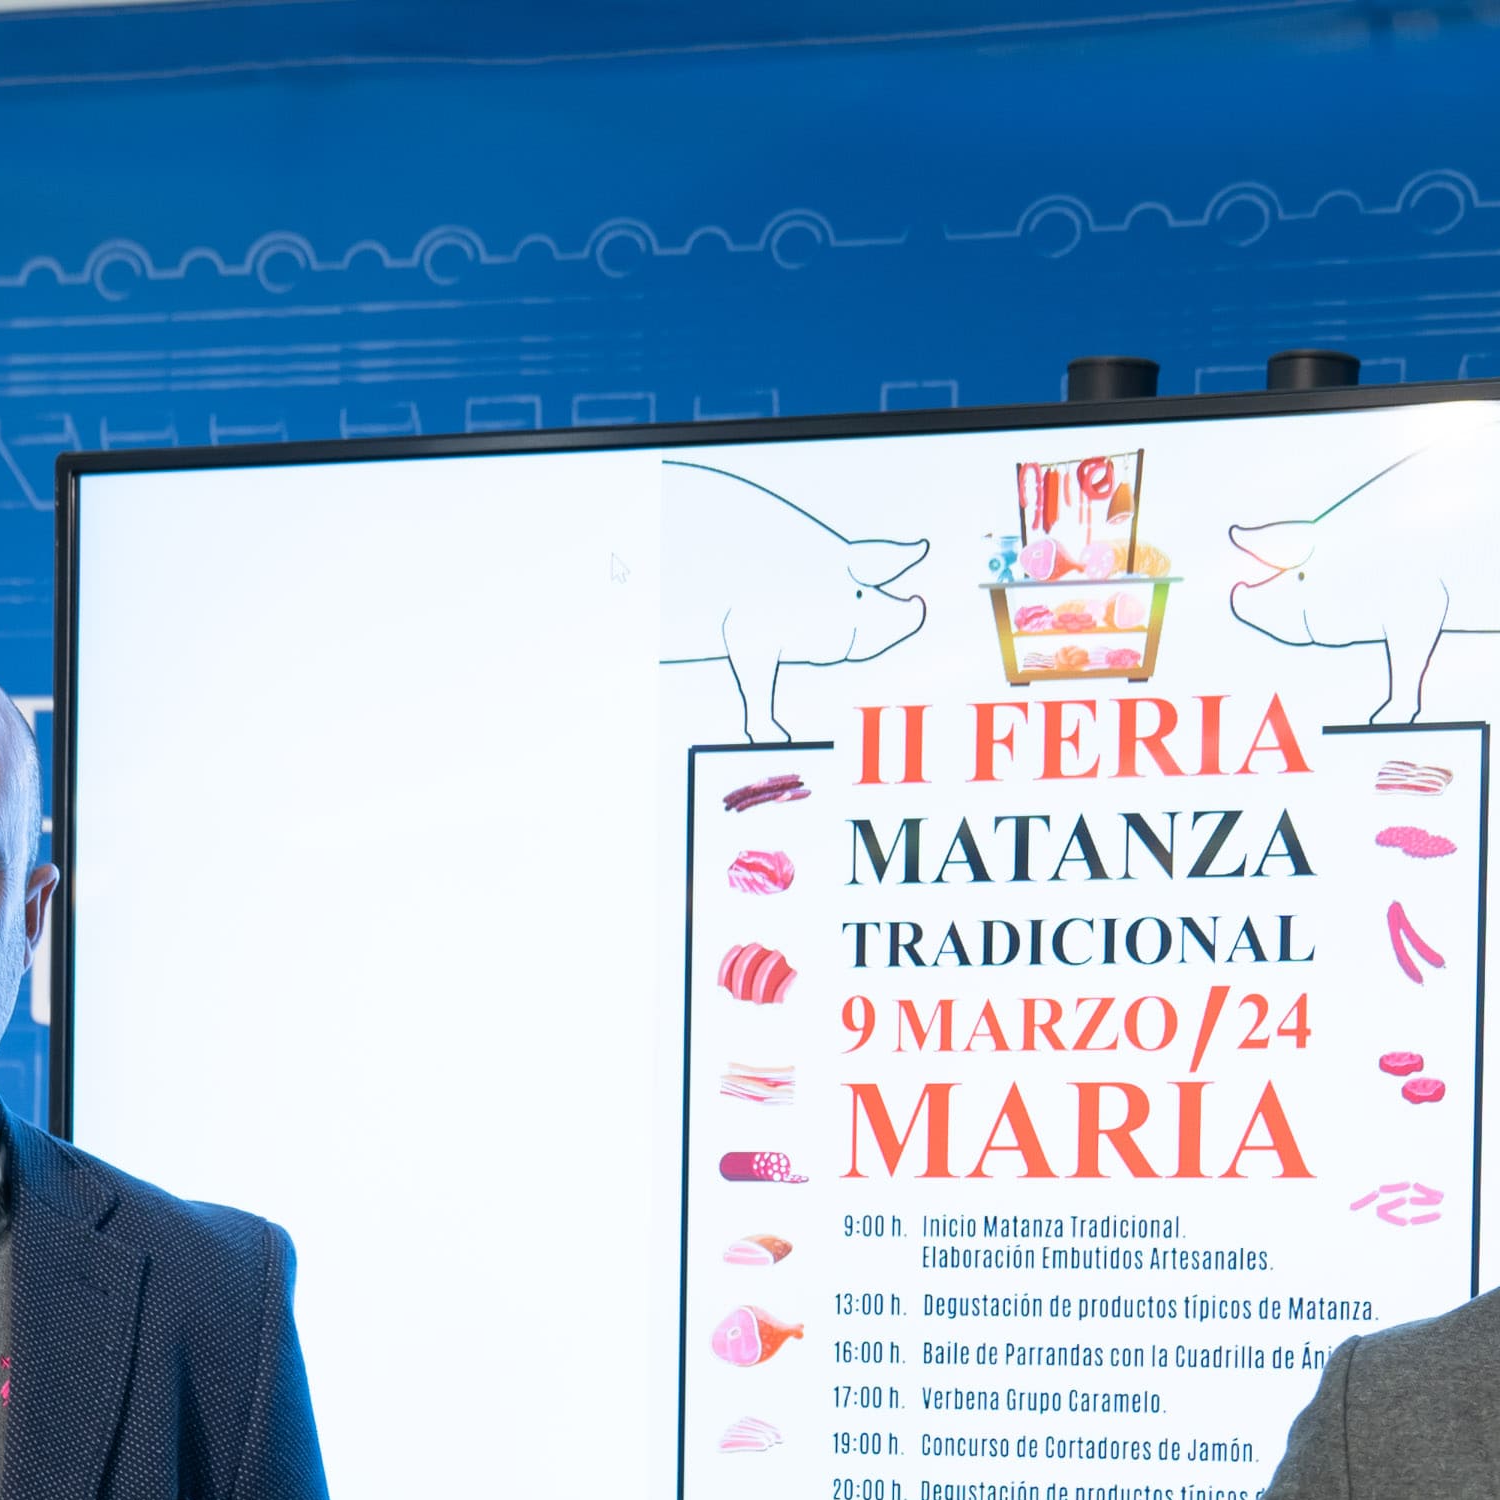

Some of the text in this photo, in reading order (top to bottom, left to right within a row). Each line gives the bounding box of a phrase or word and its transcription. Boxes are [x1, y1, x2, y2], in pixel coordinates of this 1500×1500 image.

[852, 692, 1315, 786] II FERIA
[843, 808, 1318, 886] MATANZA
[841, 914, 1316, 969] TRADICIONAL
[841, 995, 876, 1053] 9
[839, 1079, 1318, 1179] MARÍA
[843, 1214, 1186, 1240] 9:00 h. Inicio Matanza Tradicional.
[922, 1244, 1274, 1272] Elaboración Embutidos Artesanales.
[835, 1292, 1379, 1325] 13:00 h. Degustación de productos típicos de Matanza.
[834, 1340, 883, 1364] 16:00
[889, 1341, 906, 1365] h.
[923, 1340, 970, 1365] Baile
[976, 1342, 998, 1366] de
[1005, 1342, 1104, 1367] Parrandas
[1110, 1347, 1144, 1368] con
[1151, 1344, 1168, 1368] la
[1175, 1344, 1265, 1369] Cuadrilla
[1272, 1345, 1295, 1370] de
[833, 1385, 1167, 1417] 17:00 h. Verbena Grupo Caramelo.
[832, 1431, 1259, 1464] 19:00 h. Concurso de Cortadores de Jamón.
